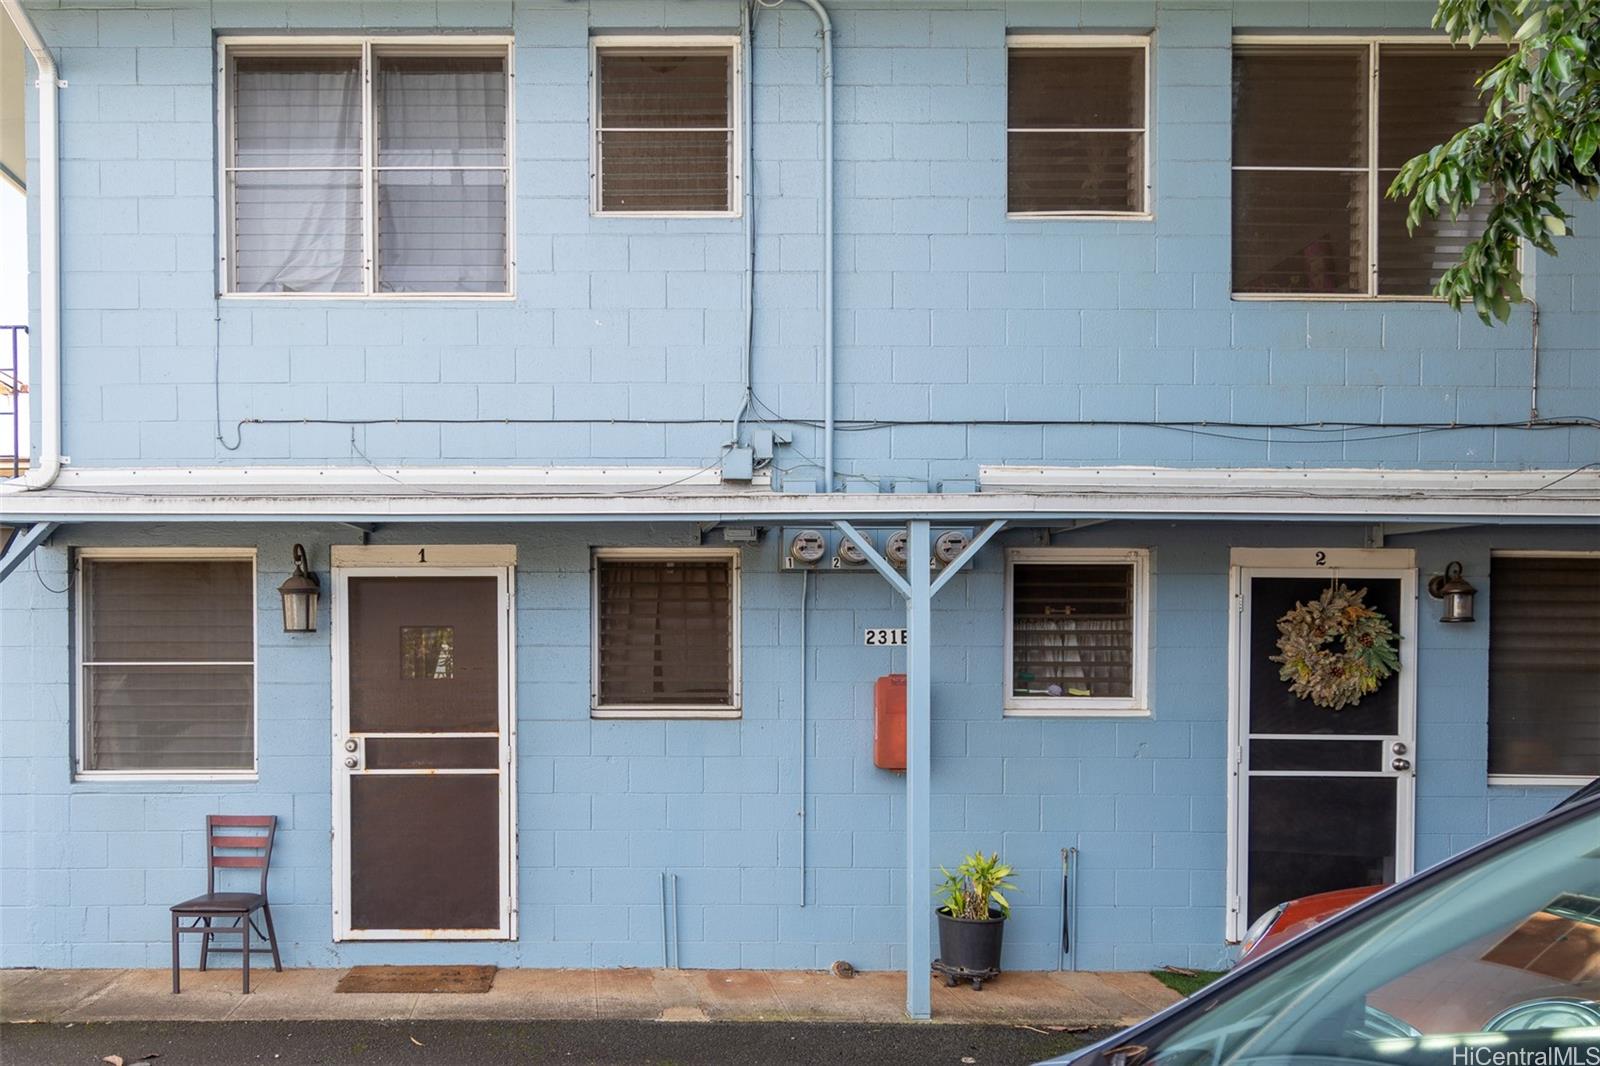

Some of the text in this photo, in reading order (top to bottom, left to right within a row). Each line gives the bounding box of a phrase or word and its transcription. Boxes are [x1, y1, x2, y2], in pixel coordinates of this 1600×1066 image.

[418, 548, 427, 563] 1
[833, 557, 840, 568] 2
[1315, 551, 1326, 566] 2
